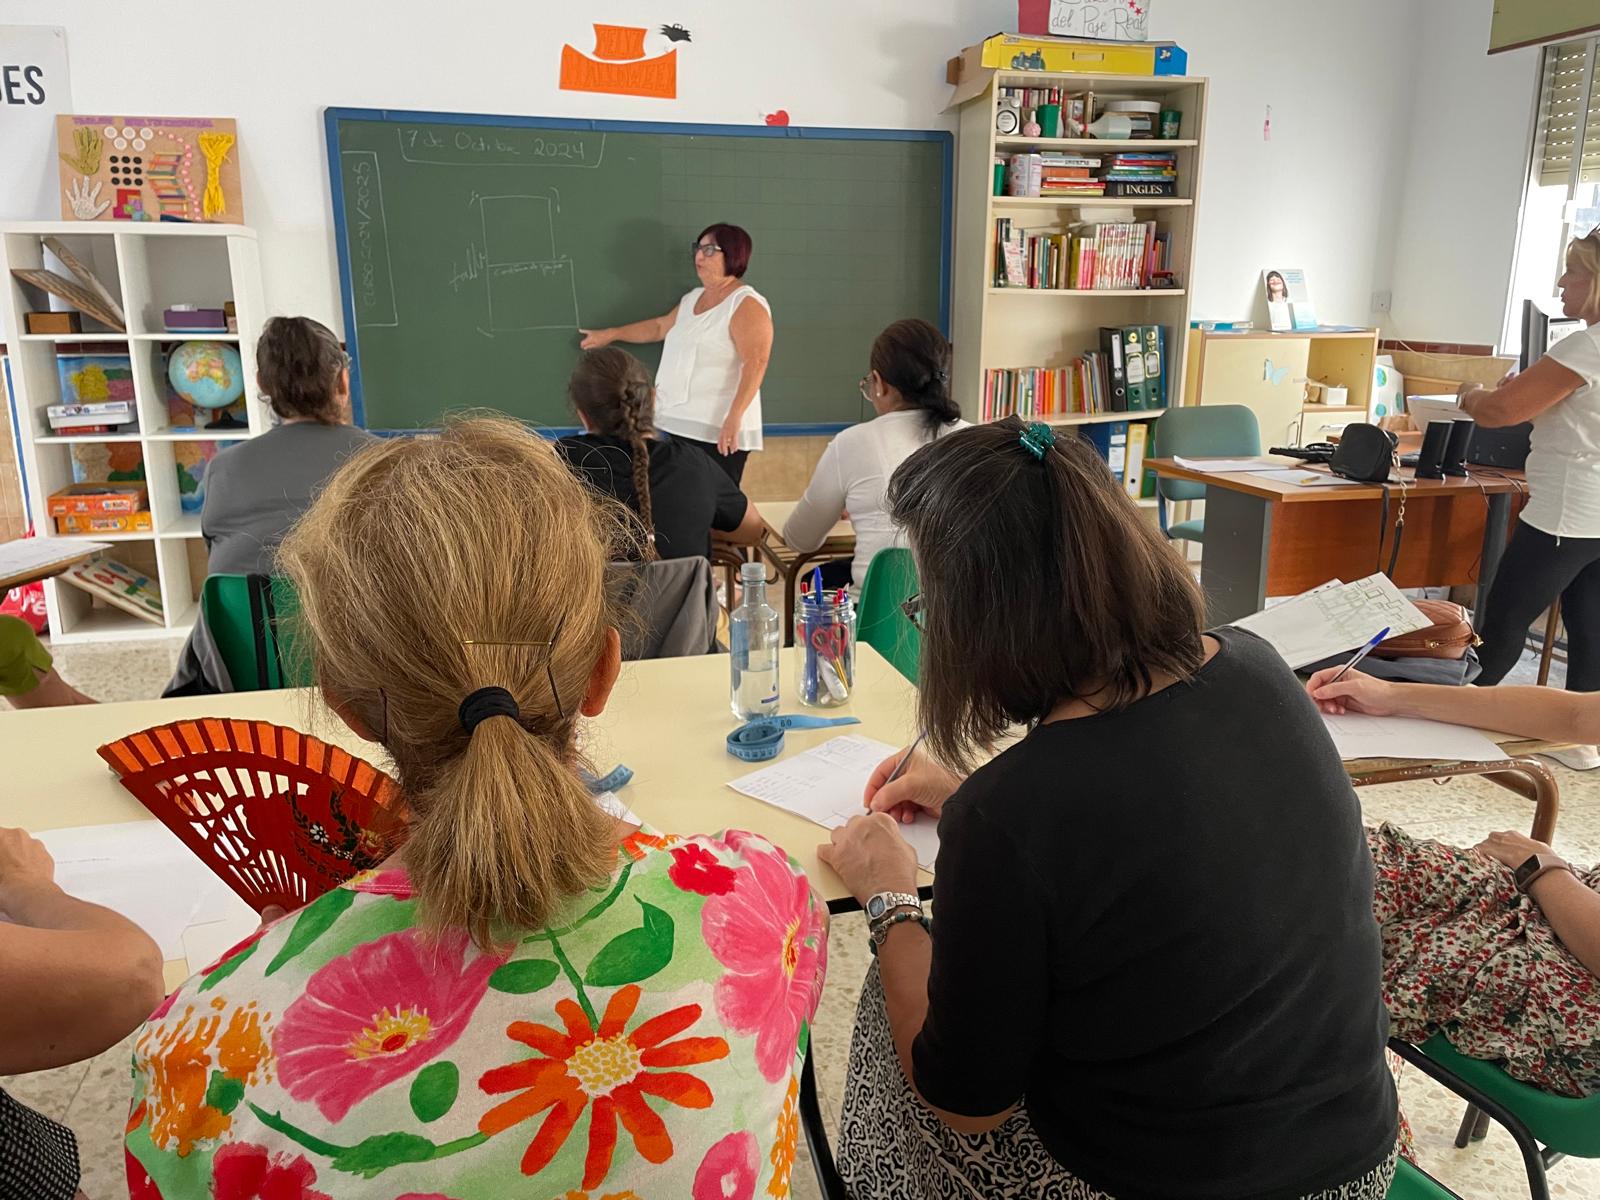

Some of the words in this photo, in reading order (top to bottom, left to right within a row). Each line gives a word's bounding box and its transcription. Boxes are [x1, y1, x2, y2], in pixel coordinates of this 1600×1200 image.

[1051, 7, 1075, 29] del
[1109, 7, 1148, 40] Real
[0, 64, 46, 105] ES
[406, 130, 419, 148] 7
[533, 137, 585, 160] 2024
